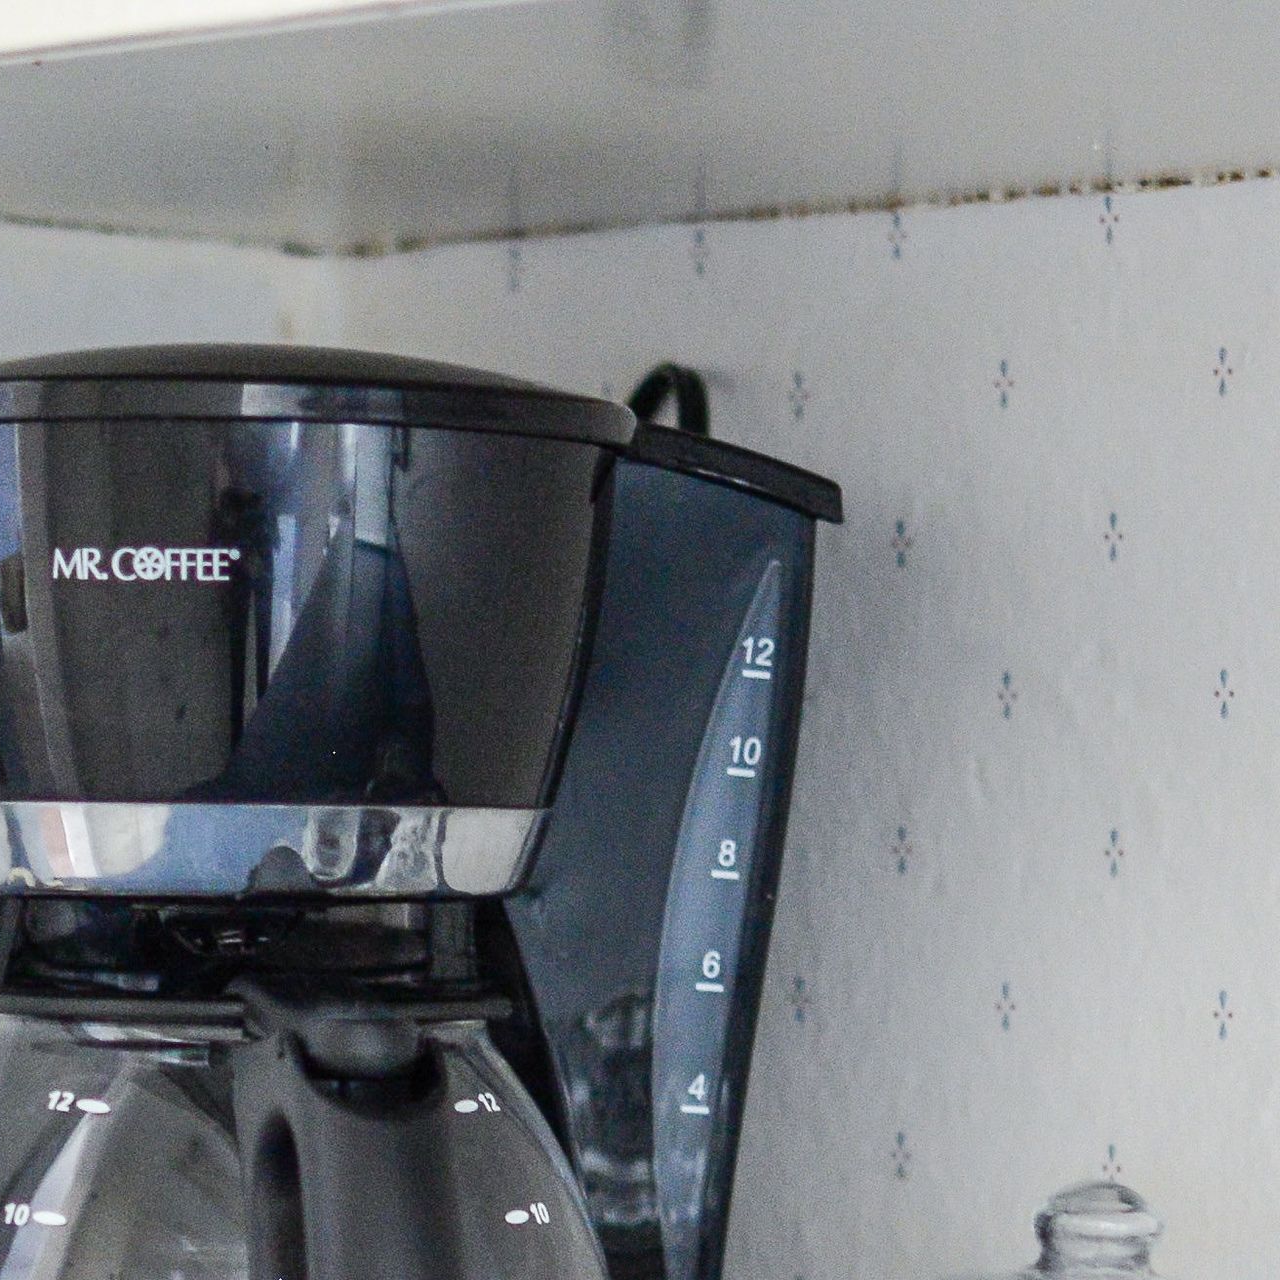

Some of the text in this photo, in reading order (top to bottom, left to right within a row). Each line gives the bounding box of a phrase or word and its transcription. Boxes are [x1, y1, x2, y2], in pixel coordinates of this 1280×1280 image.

[52, 546, 232, 582] MR. COFFEE
[742, 636, 775, 667] 12
[729, 736, 762, 765] 10
[717, 839, 736, 867] 8
[702, 950, 721, 979] 6
[47, 1090, 74, 1112] 12
[687, 1073, 706, 1101] 4
[477, 1092, 501, 1113] 12
[4, 1202, 29, 1227] 10
[529, 1202, 550, 1225] 10
